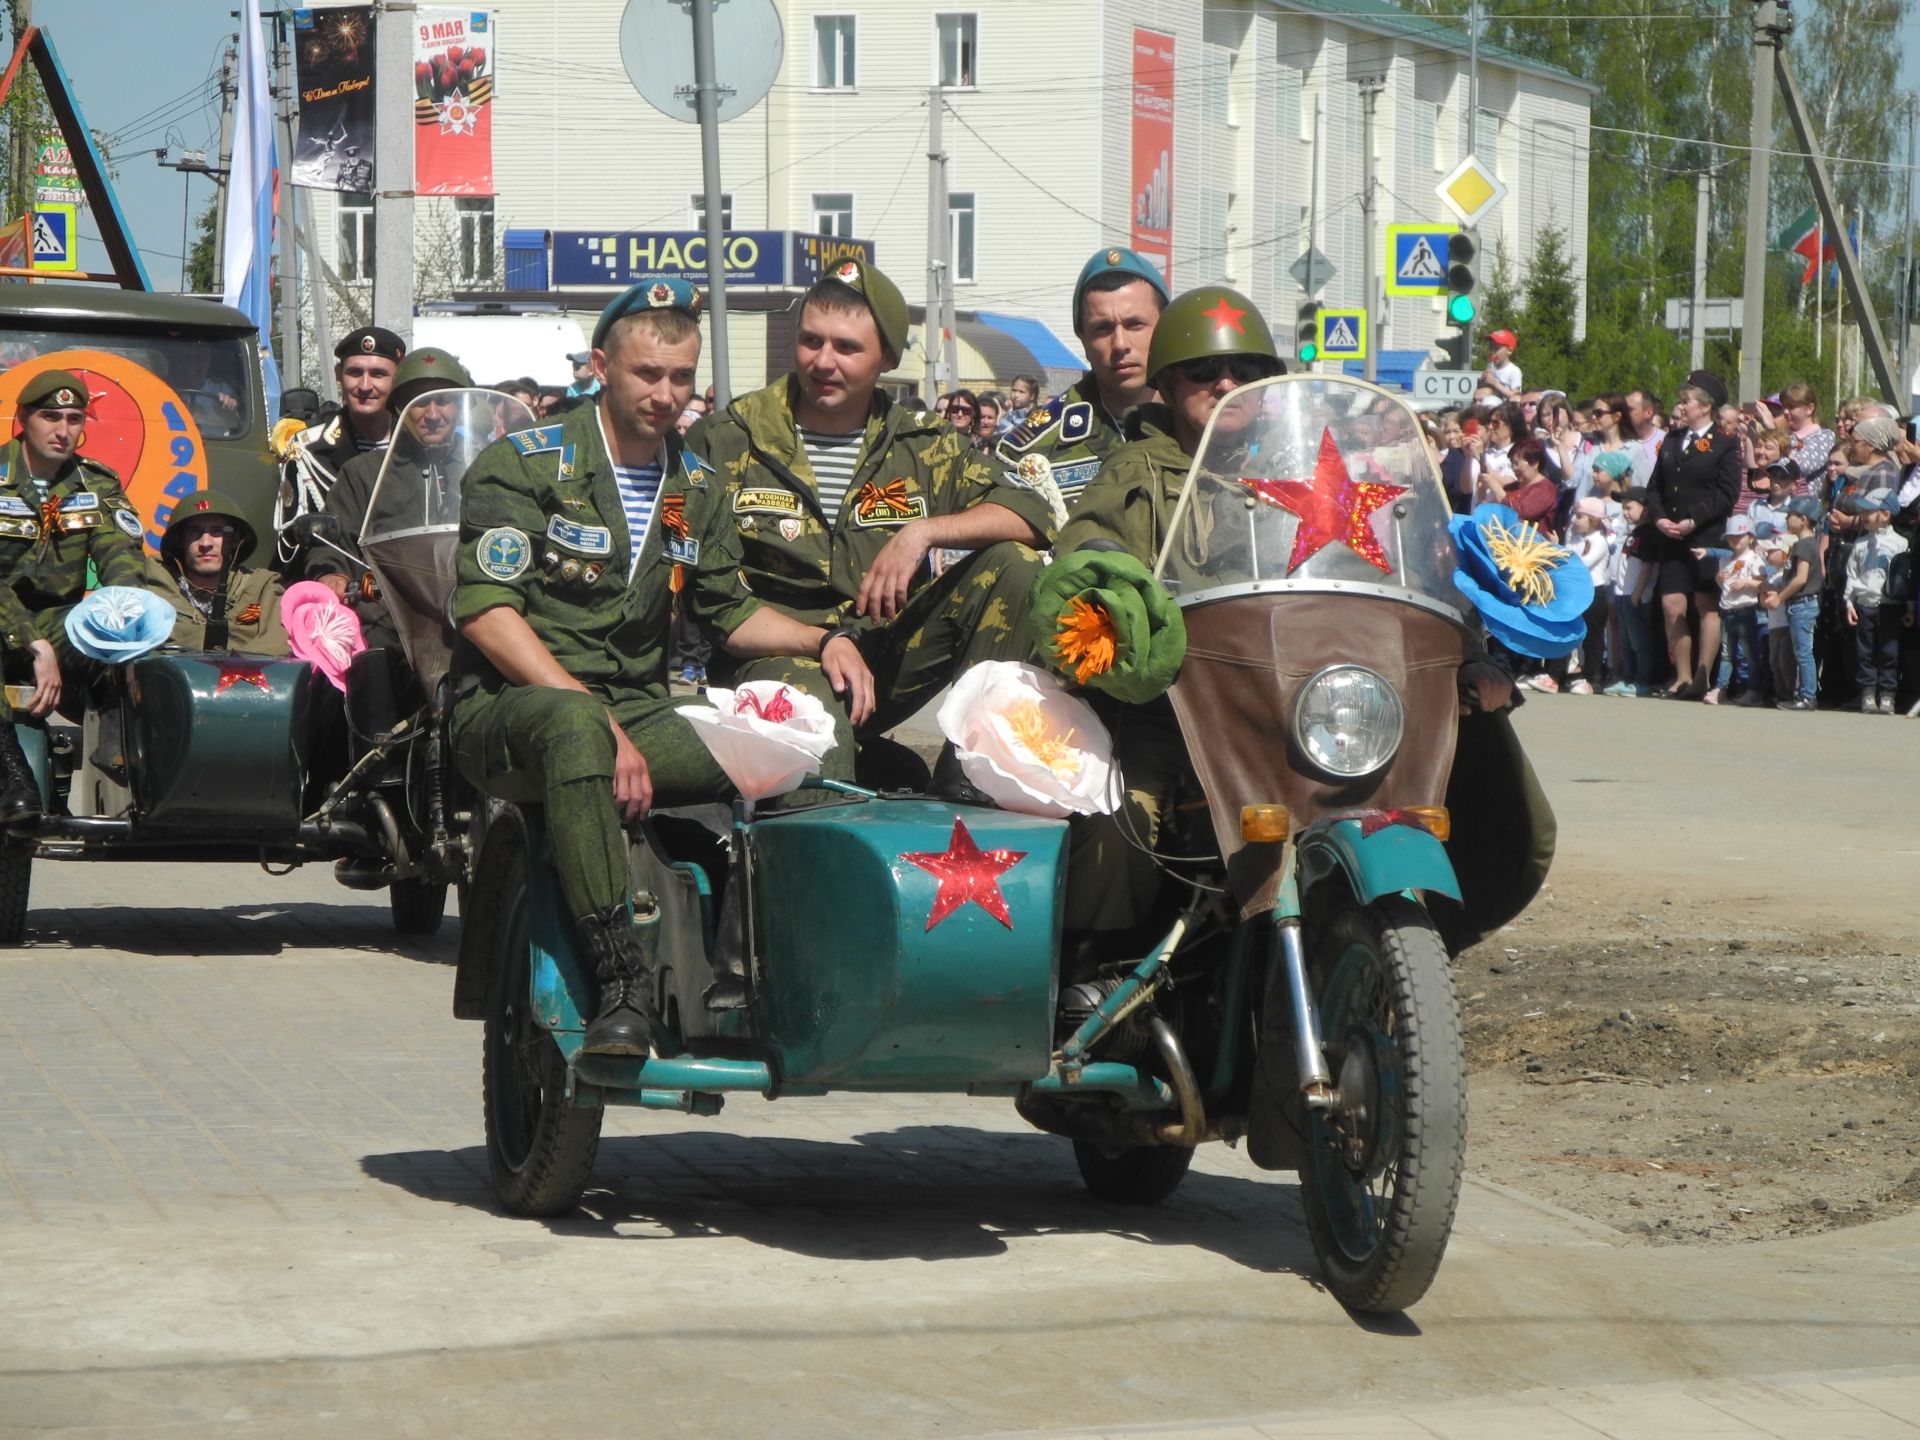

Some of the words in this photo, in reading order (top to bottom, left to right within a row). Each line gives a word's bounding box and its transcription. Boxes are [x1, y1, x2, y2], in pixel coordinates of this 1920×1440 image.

[420, 26, 430, 41] 9
[432, 20, 464, 39] МАЯ
[40, 146, 72, 162] АЯ
[629, 236, 758, 270] НАСКО
[1424, 376, 1472, 394] СТО
[144, 401, 198, 551] 1945
[757, 500, 795, 509] РАЗВЕДКА
[760, 493, 795, 503] ВОЕННАЯ
